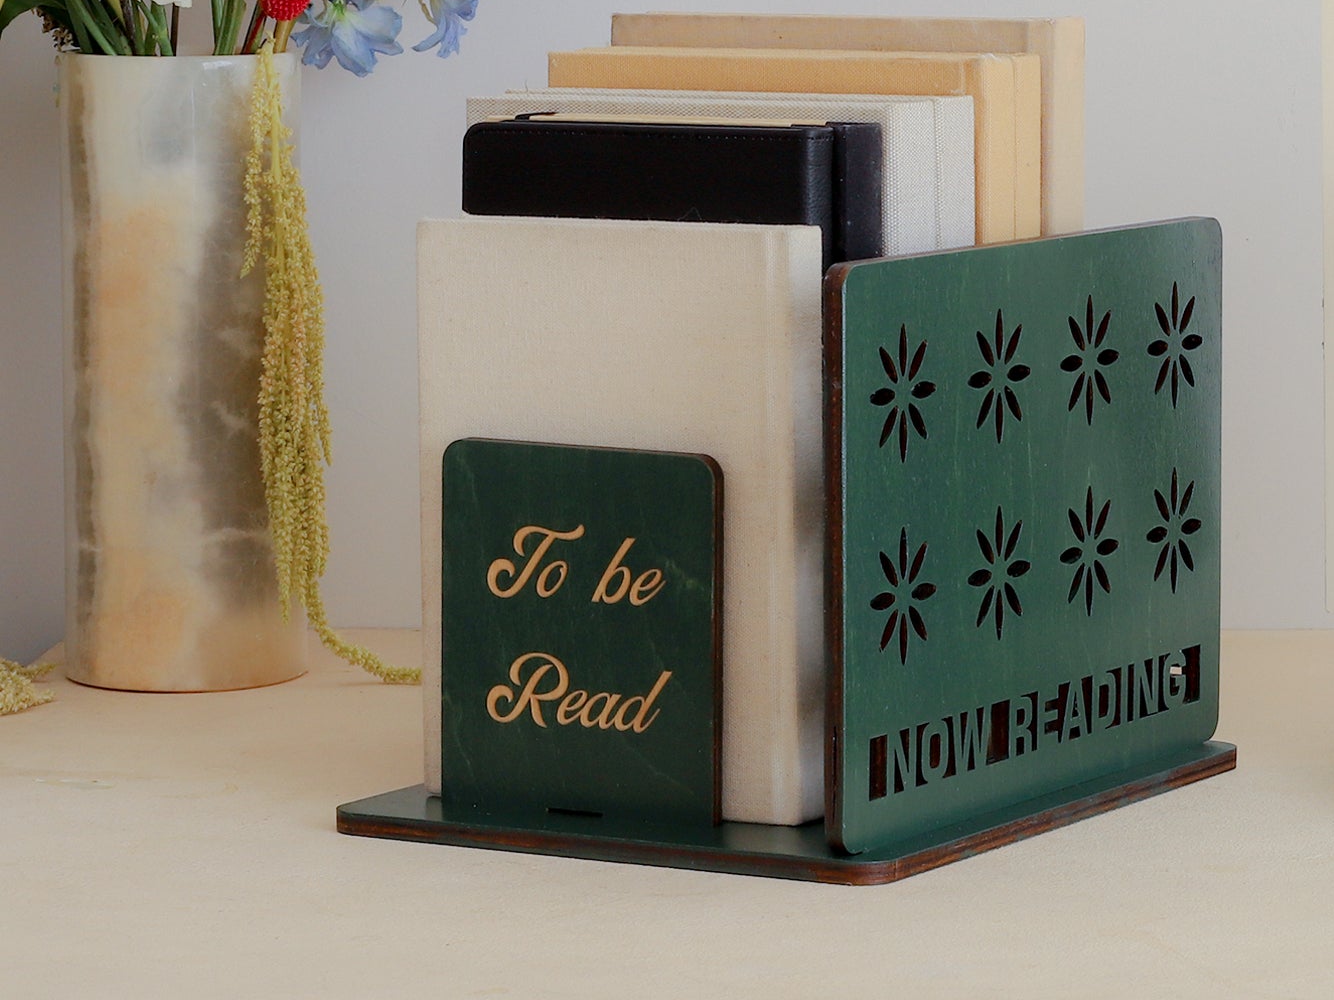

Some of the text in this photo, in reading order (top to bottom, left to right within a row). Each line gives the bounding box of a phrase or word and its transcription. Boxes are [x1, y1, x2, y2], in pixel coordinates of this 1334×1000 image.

[486, 524, 667, 606] To be
[486, 652, 673, 733] Read
[887, 649, 1188, 797] NOW READING
